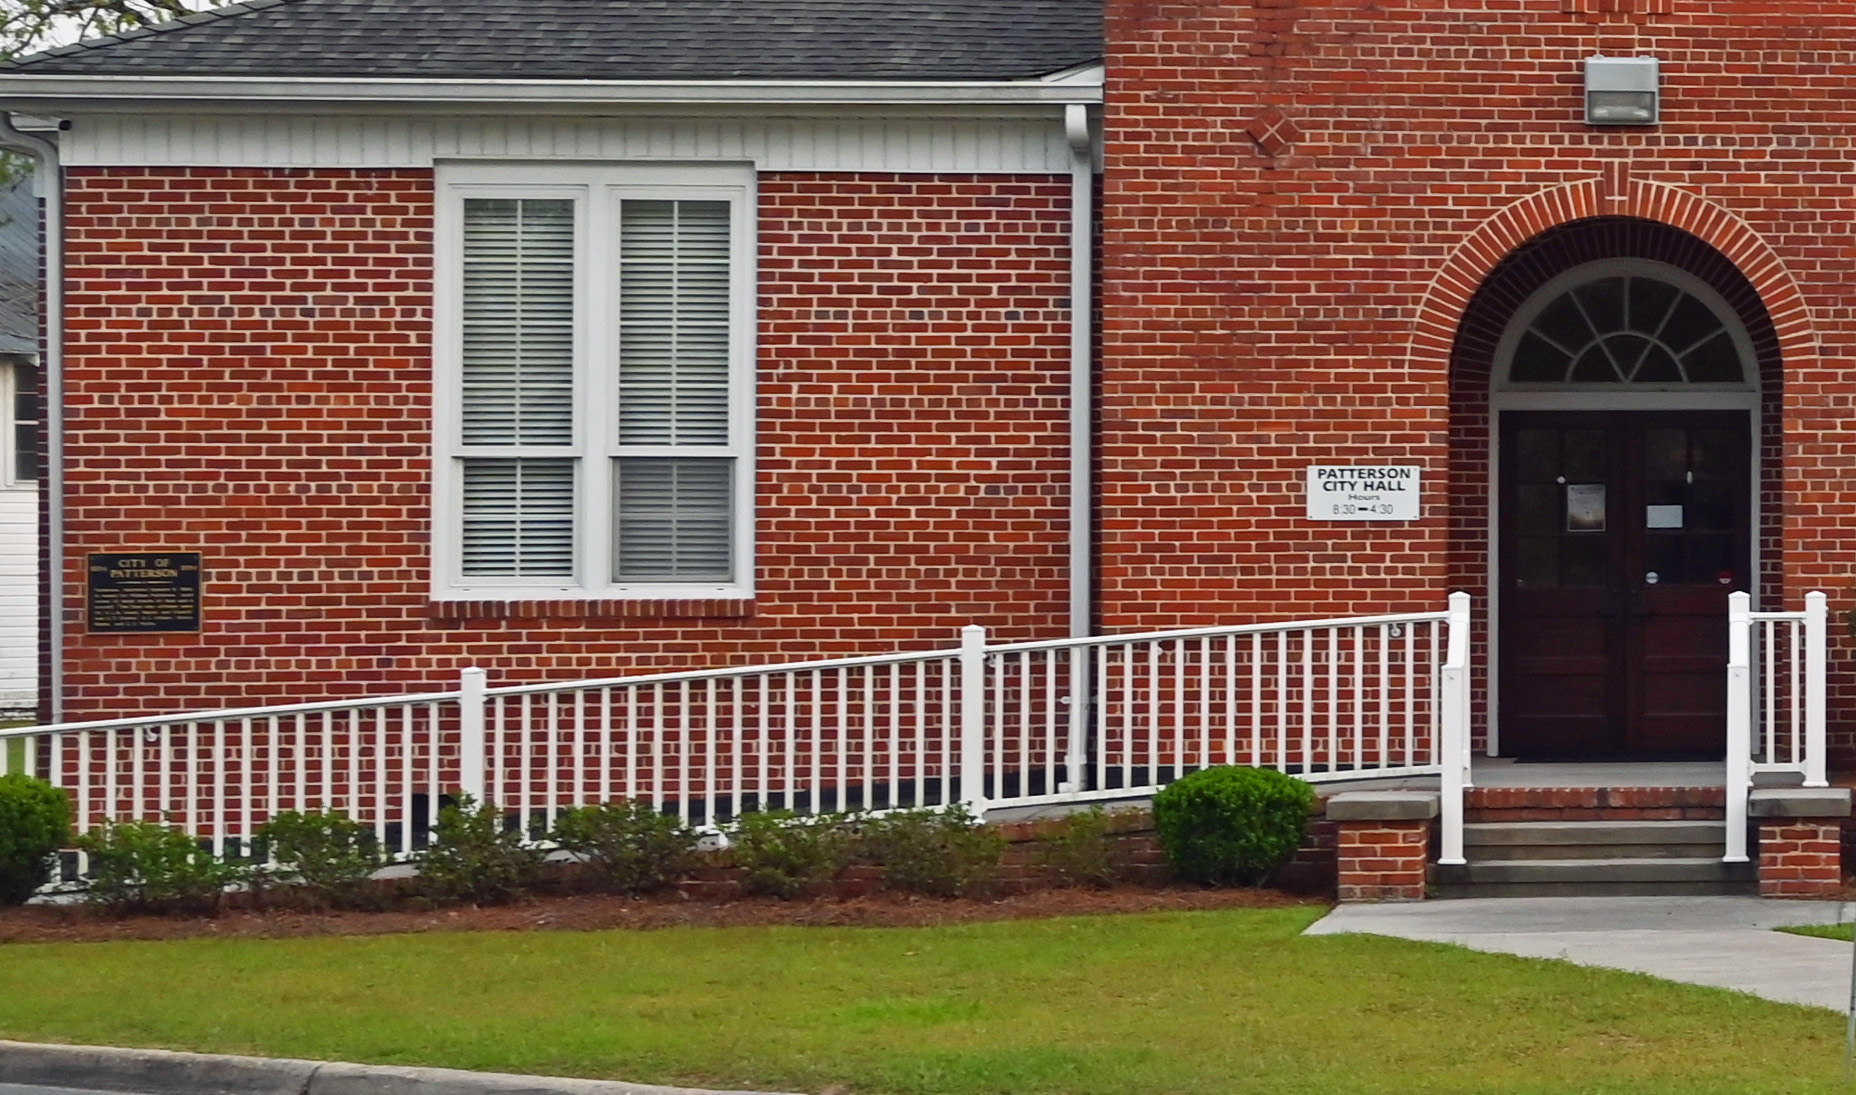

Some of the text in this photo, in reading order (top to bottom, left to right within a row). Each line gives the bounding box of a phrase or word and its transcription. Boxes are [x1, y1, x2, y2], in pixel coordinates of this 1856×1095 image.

[1317, 468, 1411, 479] PATTERSON
[1322, 480, 1407, 492] CITY HALL
[117, 558, 147, 568] CITY
[109, 569, 179, 578] PATTERSON
